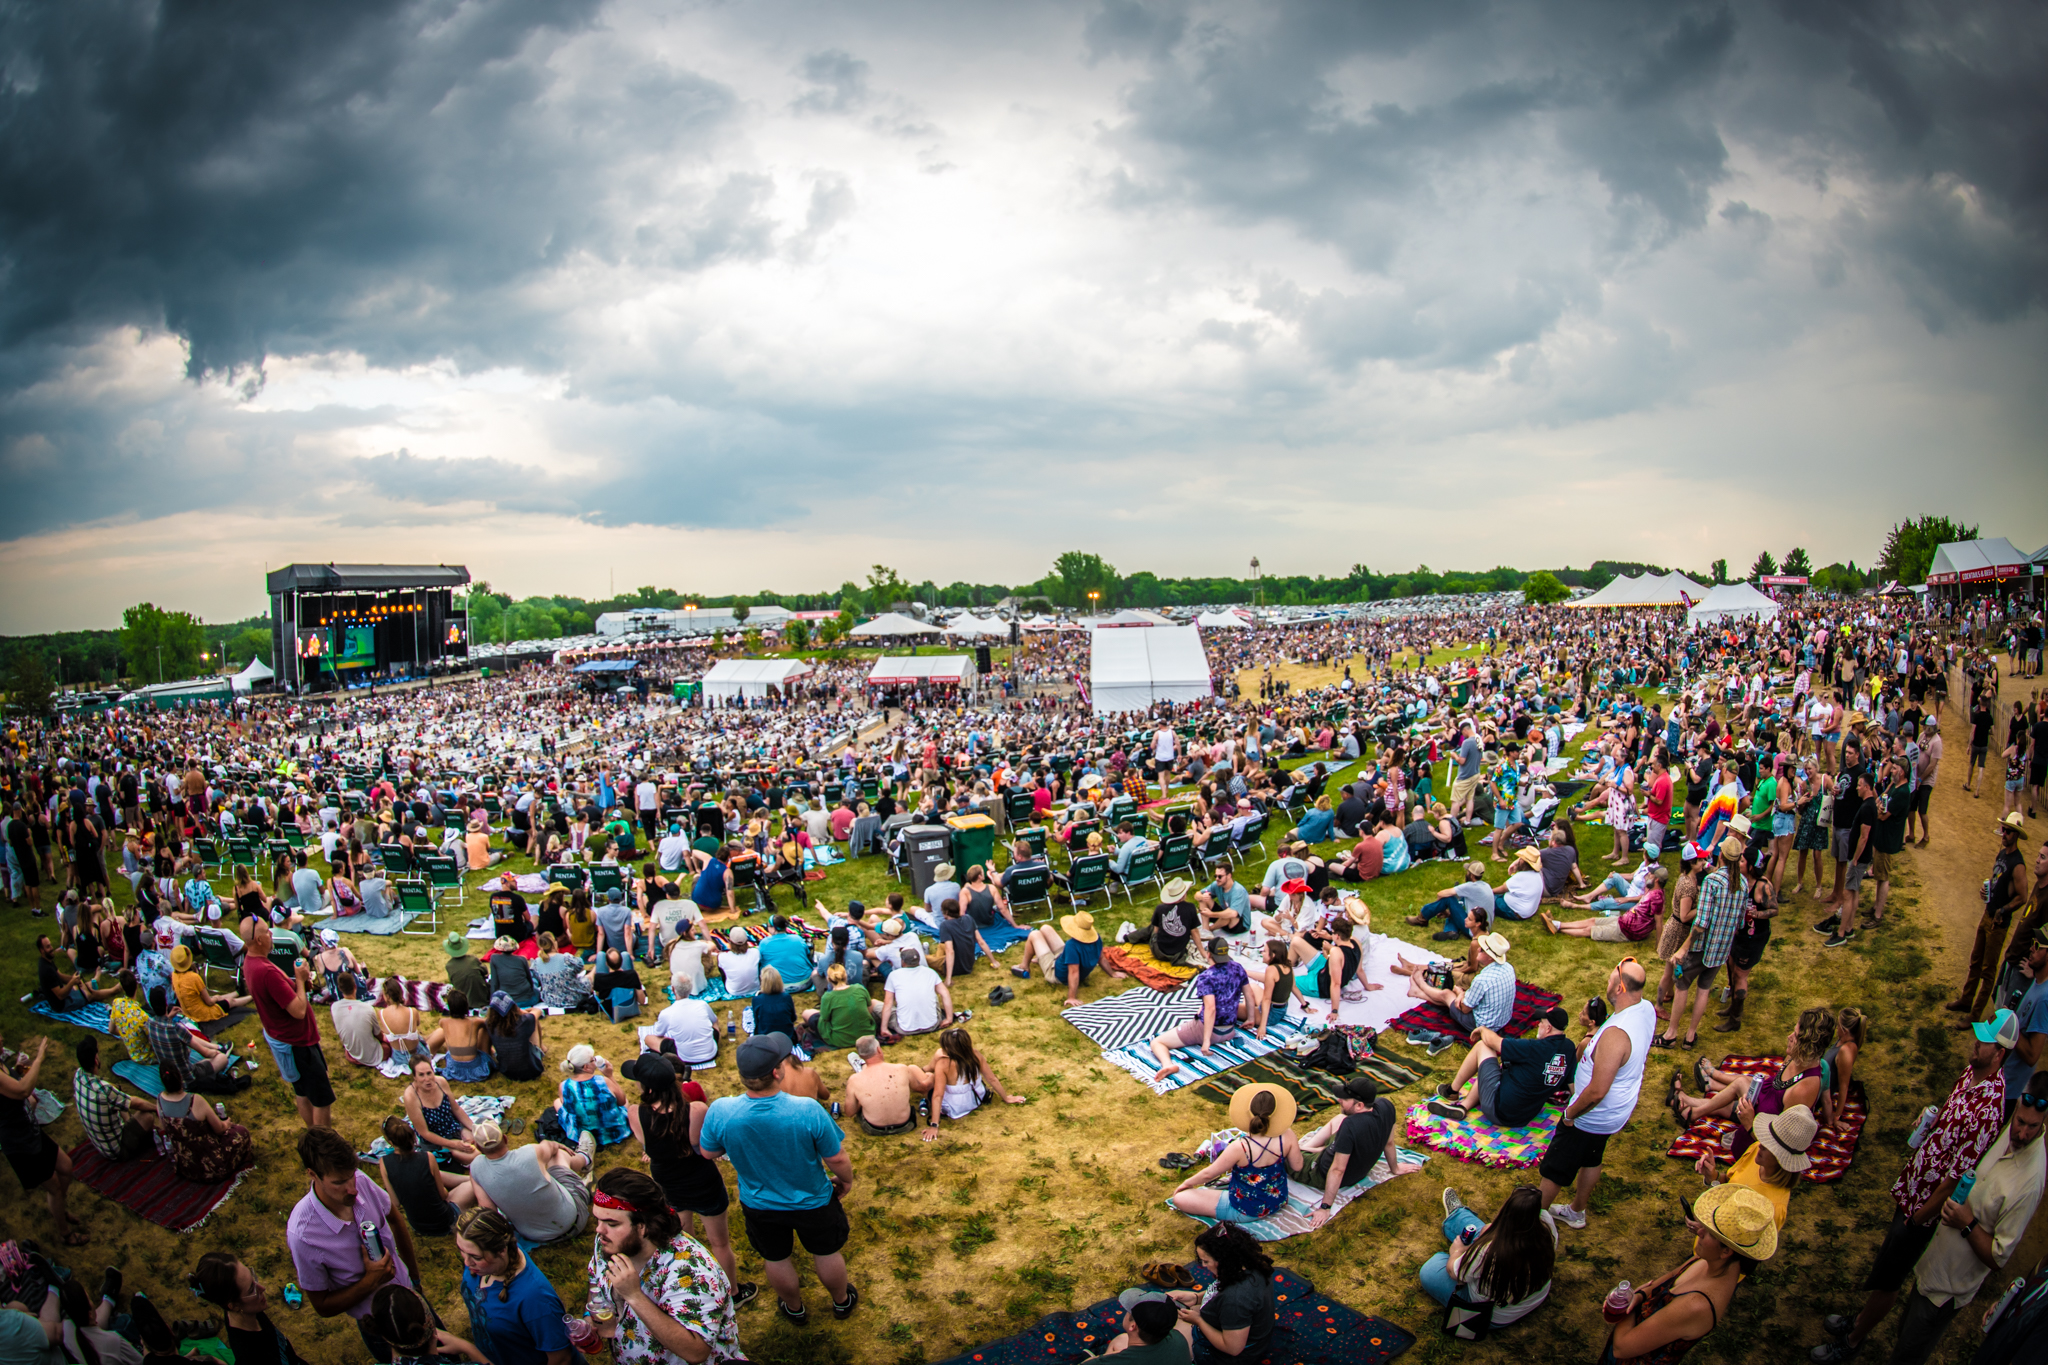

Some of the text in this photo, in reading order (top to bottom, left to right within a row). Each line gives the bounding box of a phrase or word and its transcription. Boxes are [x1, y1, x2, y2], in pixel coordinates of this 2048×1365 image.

[1962, 570, 1980, 580] COCKTAILS
[1076, 827, 1094, 835] RENTAL
[1248, 823, 1263, 832] RENTAL
[1212, 832, 1229, 842] RENTAL
[1170, 844, 1188, 852] RENTAL
[1134, 854, 1154, 864] RENTAL
[1080, 865, 1104, 874] RENTAL
[1018, 876, 1042, 886] RENTAL
[202, 937, 222, 946] RENTAL
